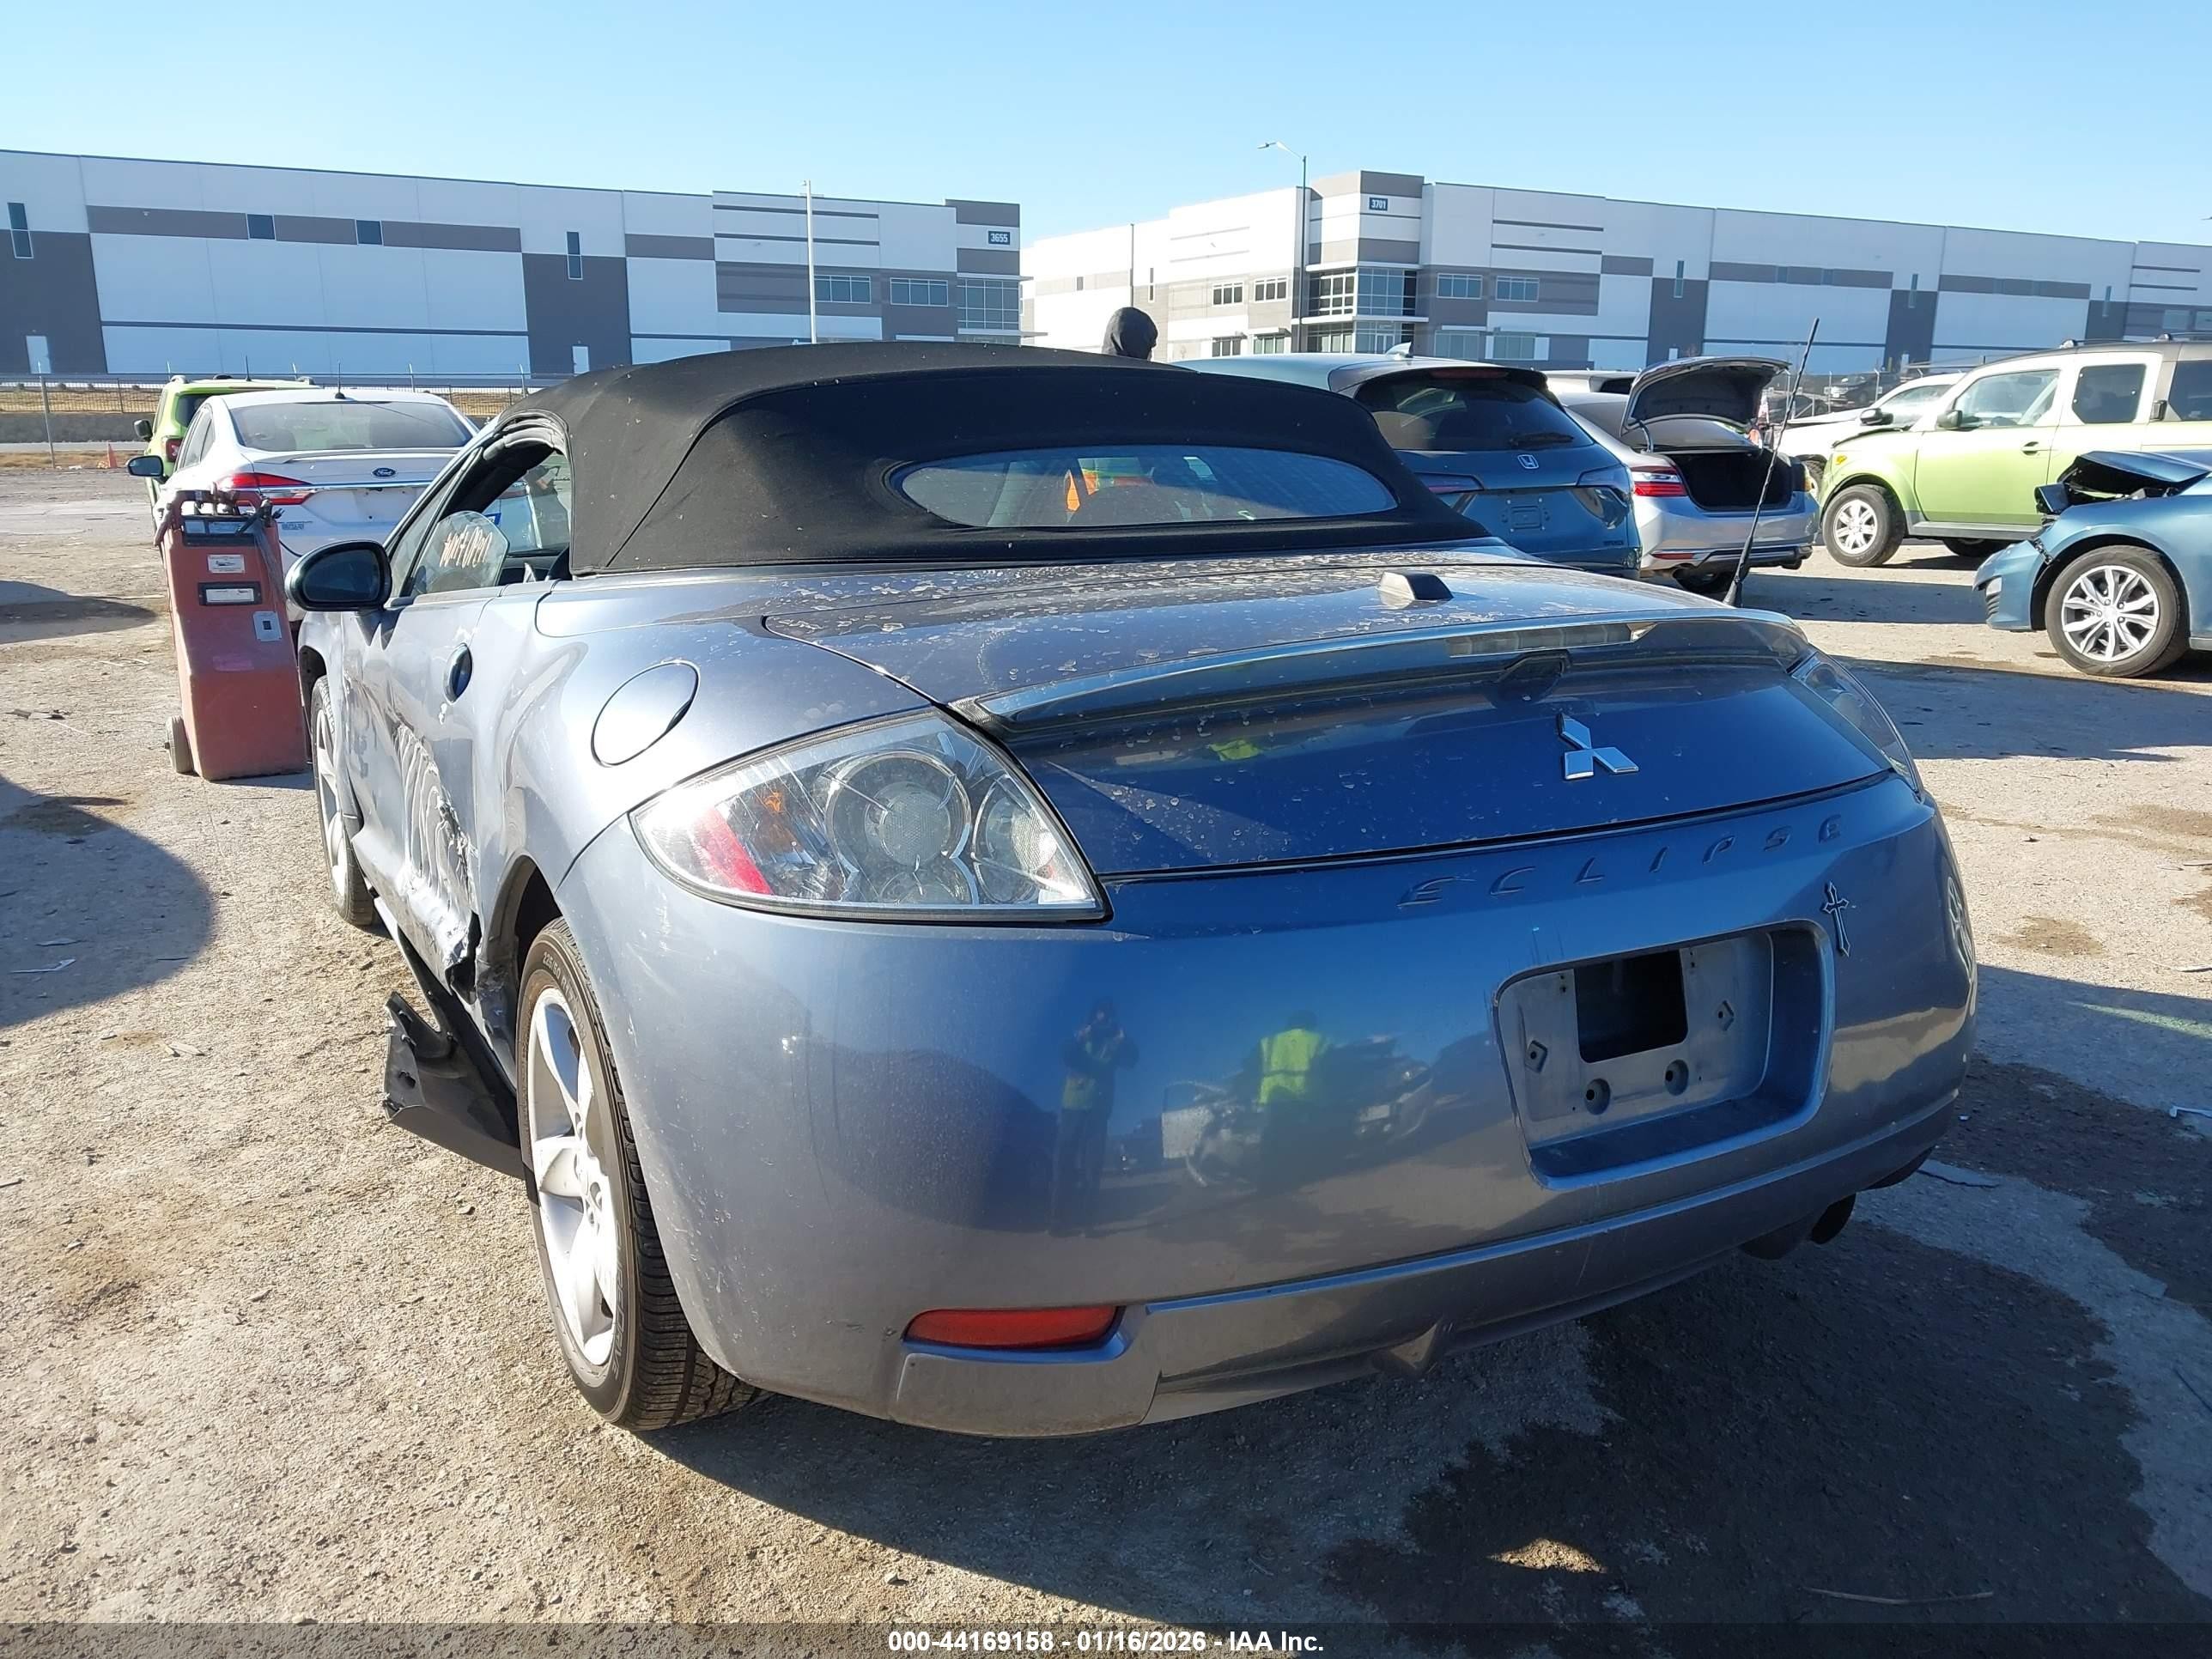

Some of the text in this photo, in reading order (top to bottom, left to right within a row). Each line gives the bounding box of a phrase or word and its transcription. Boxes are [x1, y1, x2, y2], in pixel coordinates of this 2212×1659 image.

[1371, 199, 1386, 210] 3701
[990, 233, 1008, 243] 3655
[1397, 814, 1842, 907] ECLIPSE
